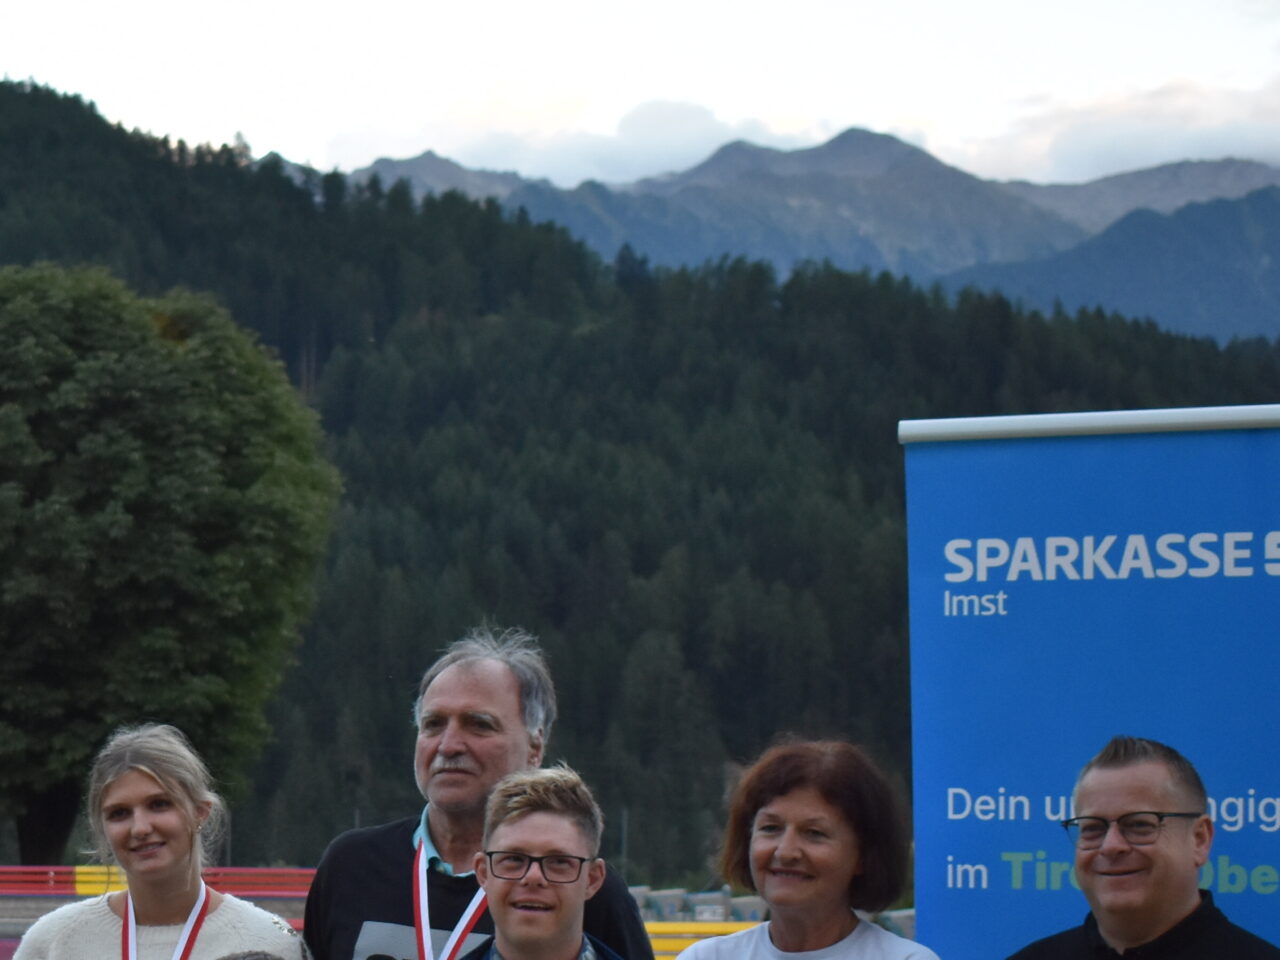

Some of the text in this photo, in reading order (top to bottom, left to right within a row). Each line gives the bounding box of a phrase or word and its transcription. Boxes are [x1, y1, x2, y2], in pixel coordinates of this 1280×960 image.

[944, 532, 1254, 583] SPARKASSE
[944, 590, 1008, 616] Imst
[947, 787, 1030, 821] Dein
[947, 855, 988, 889] im
